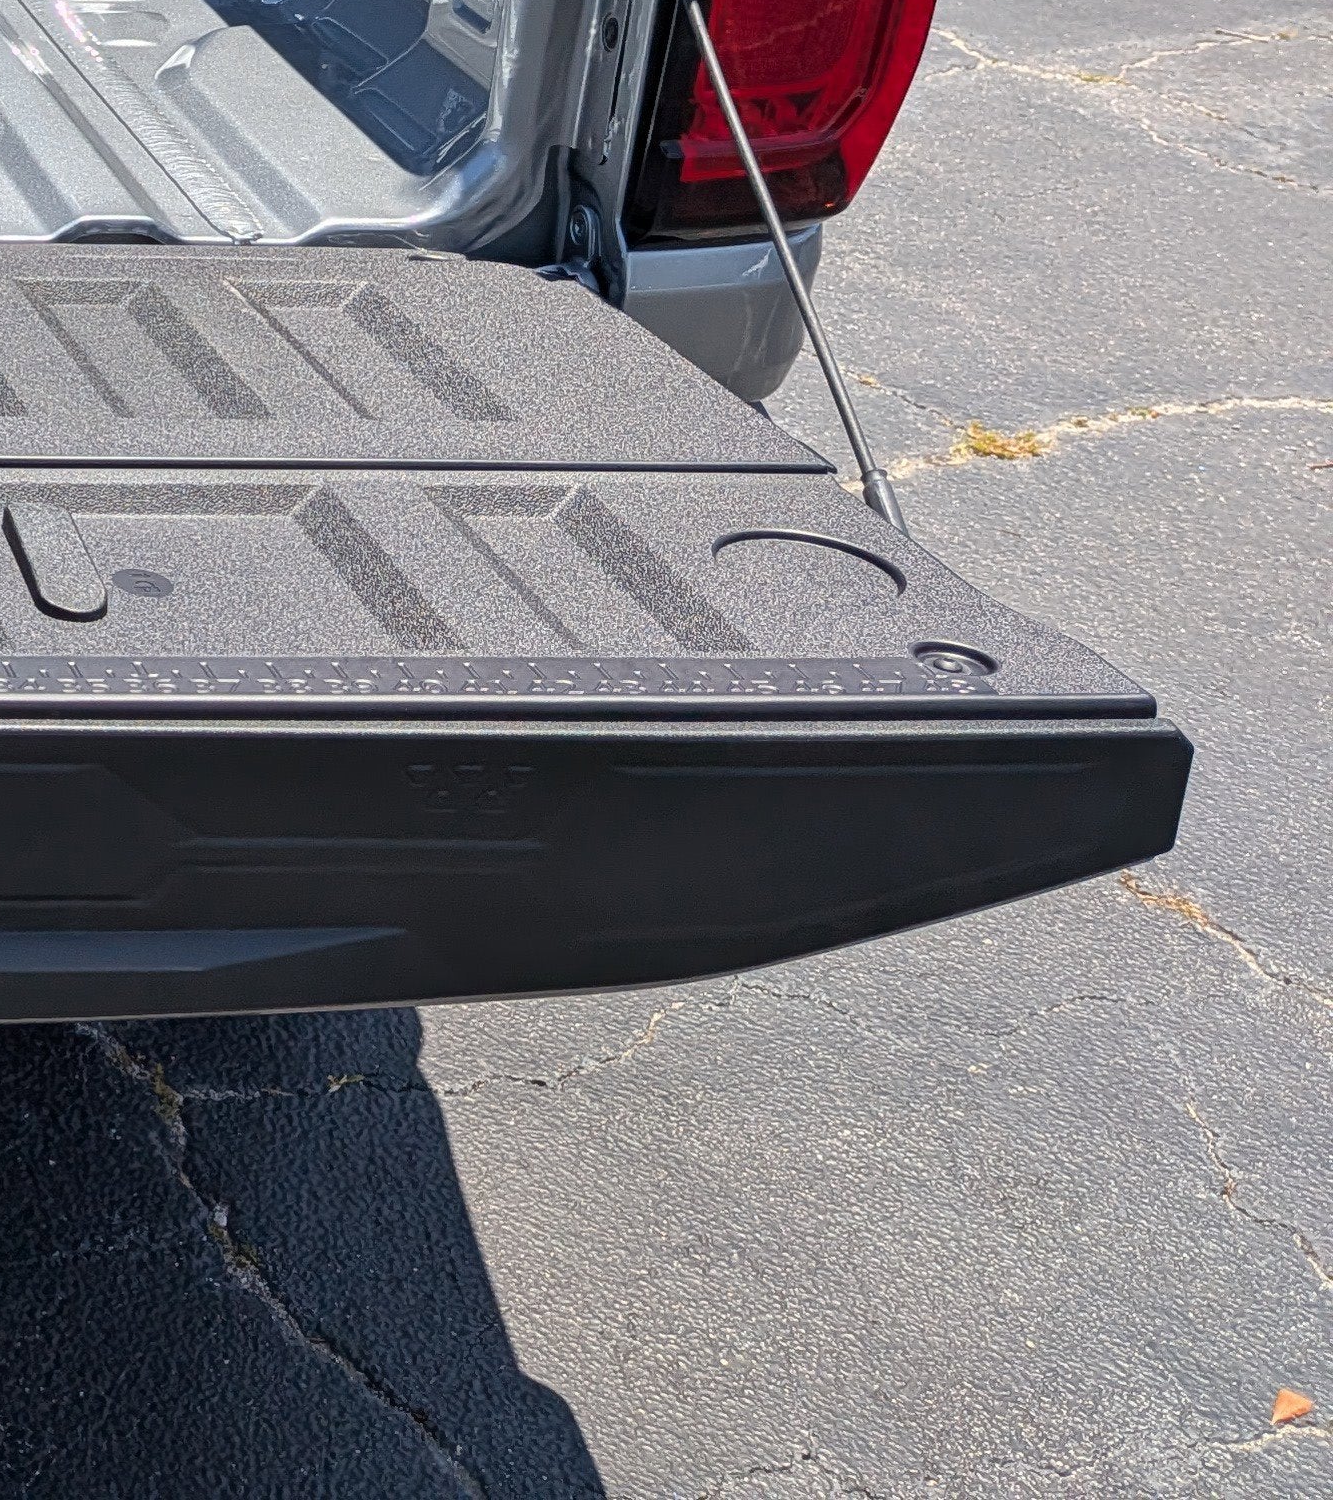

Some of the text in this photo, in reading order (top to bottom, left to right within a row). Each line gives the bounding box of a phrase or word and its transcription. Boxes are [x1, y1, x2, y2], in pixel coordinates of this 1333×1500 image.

[56, 678, 110, 692] 35
[189, 678, 242, 693] 37
[322, 679, 377, 693] 39
